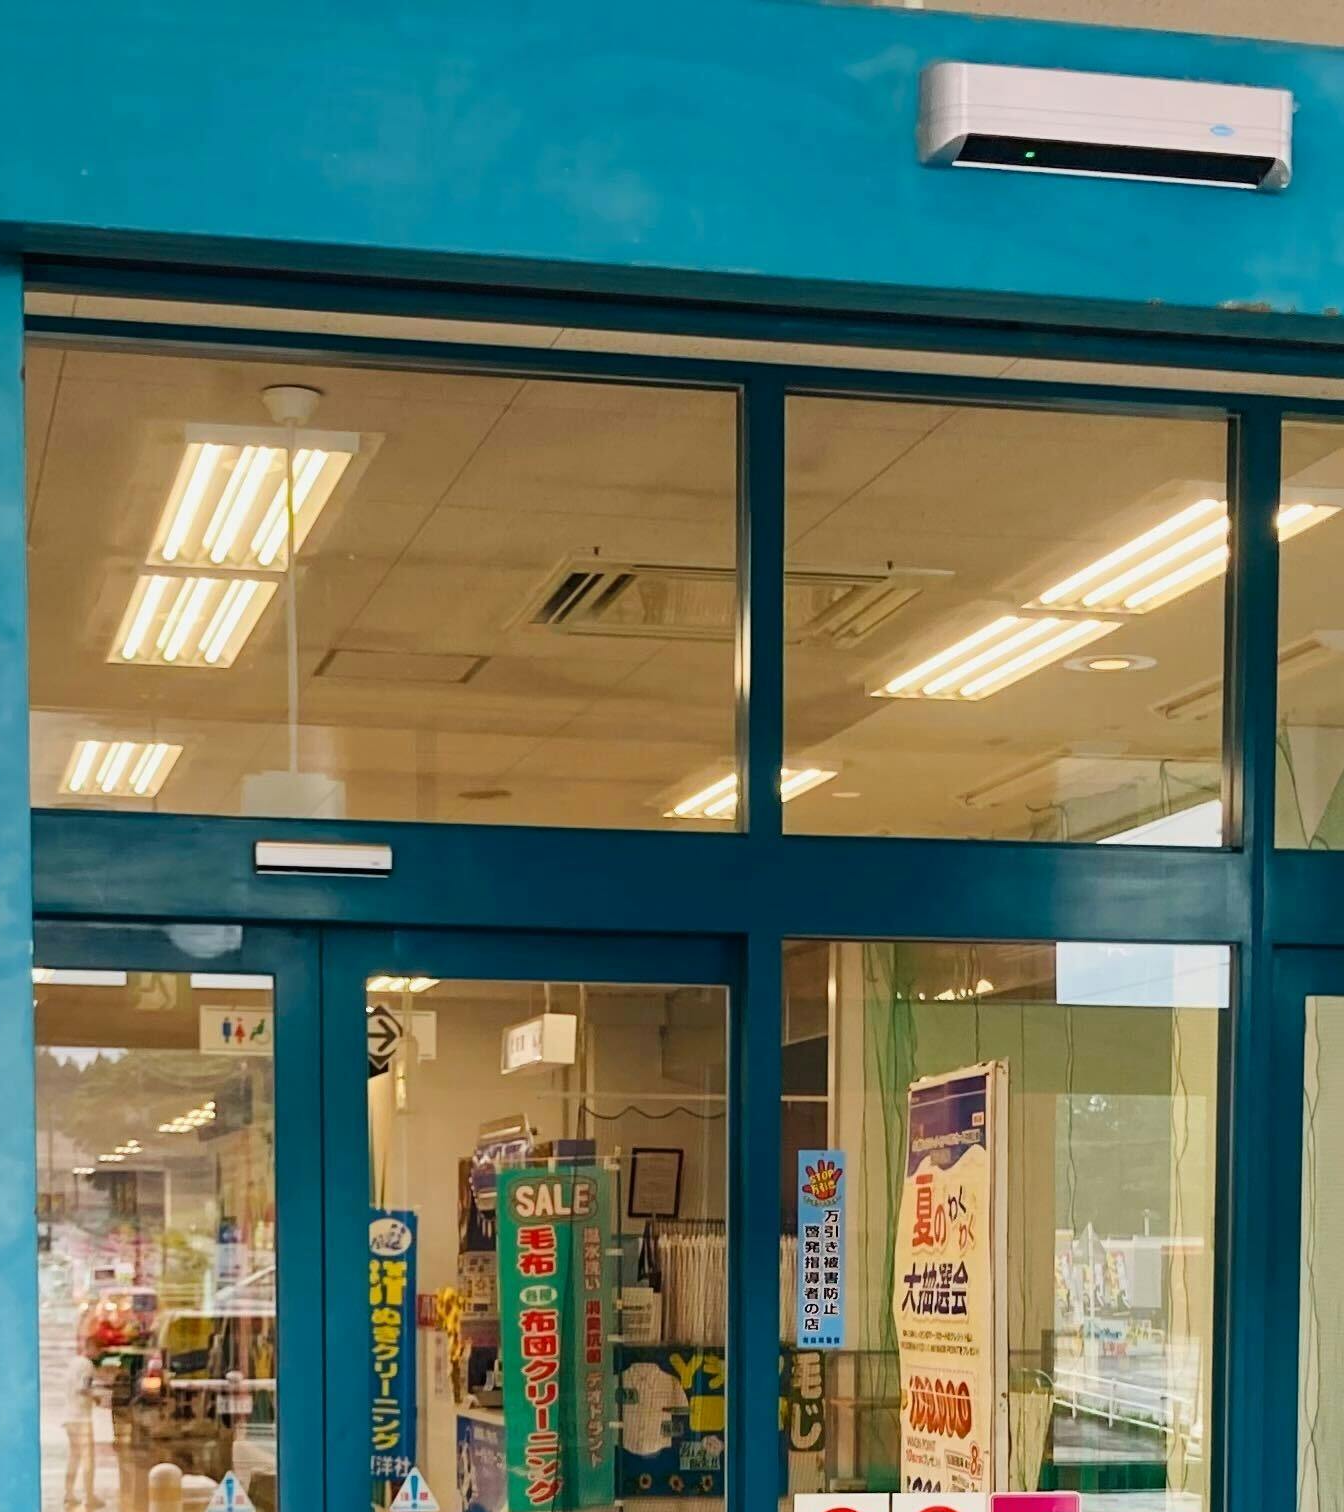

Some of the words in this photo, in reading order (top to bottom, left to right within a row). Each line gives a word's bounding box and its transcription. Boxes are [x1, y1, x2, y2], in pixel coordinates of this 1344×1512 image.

[515, 1183, 590, 1217] SALE
[517, 1225, 555, 1277] 毛布
[823, 1209, 839, 1316] 万引き被害防止
[901, 1260, 969, 1316] 大抽選会
[519, 1308, 563, 1505] 布団クリーニング
